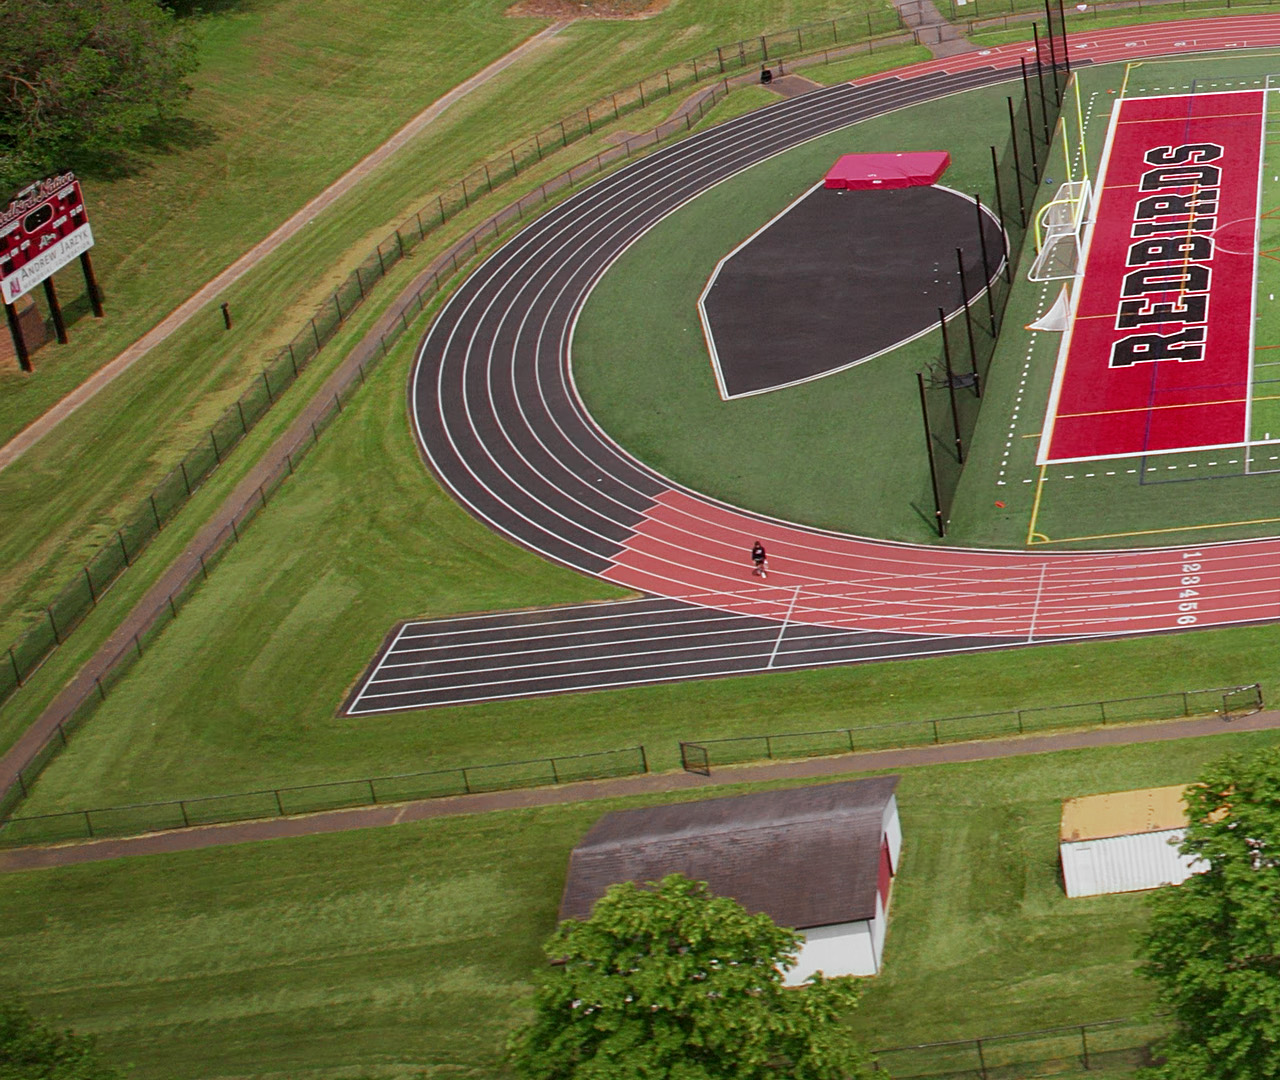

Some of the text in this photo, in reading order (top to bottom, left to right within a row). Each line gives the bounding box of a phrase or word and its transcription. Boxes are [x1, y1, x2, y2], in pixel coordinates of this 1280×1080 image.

[1108, 143, 1224, 368] REDBIRDS
[1182, 563, 1201, 572] 2
[1181, 576, 1200, 585] 3
[1179, 589, 1200, 598] 4
[1178, 602, 1198, 611] 5
[1177, 615, 1197, 624] 6
